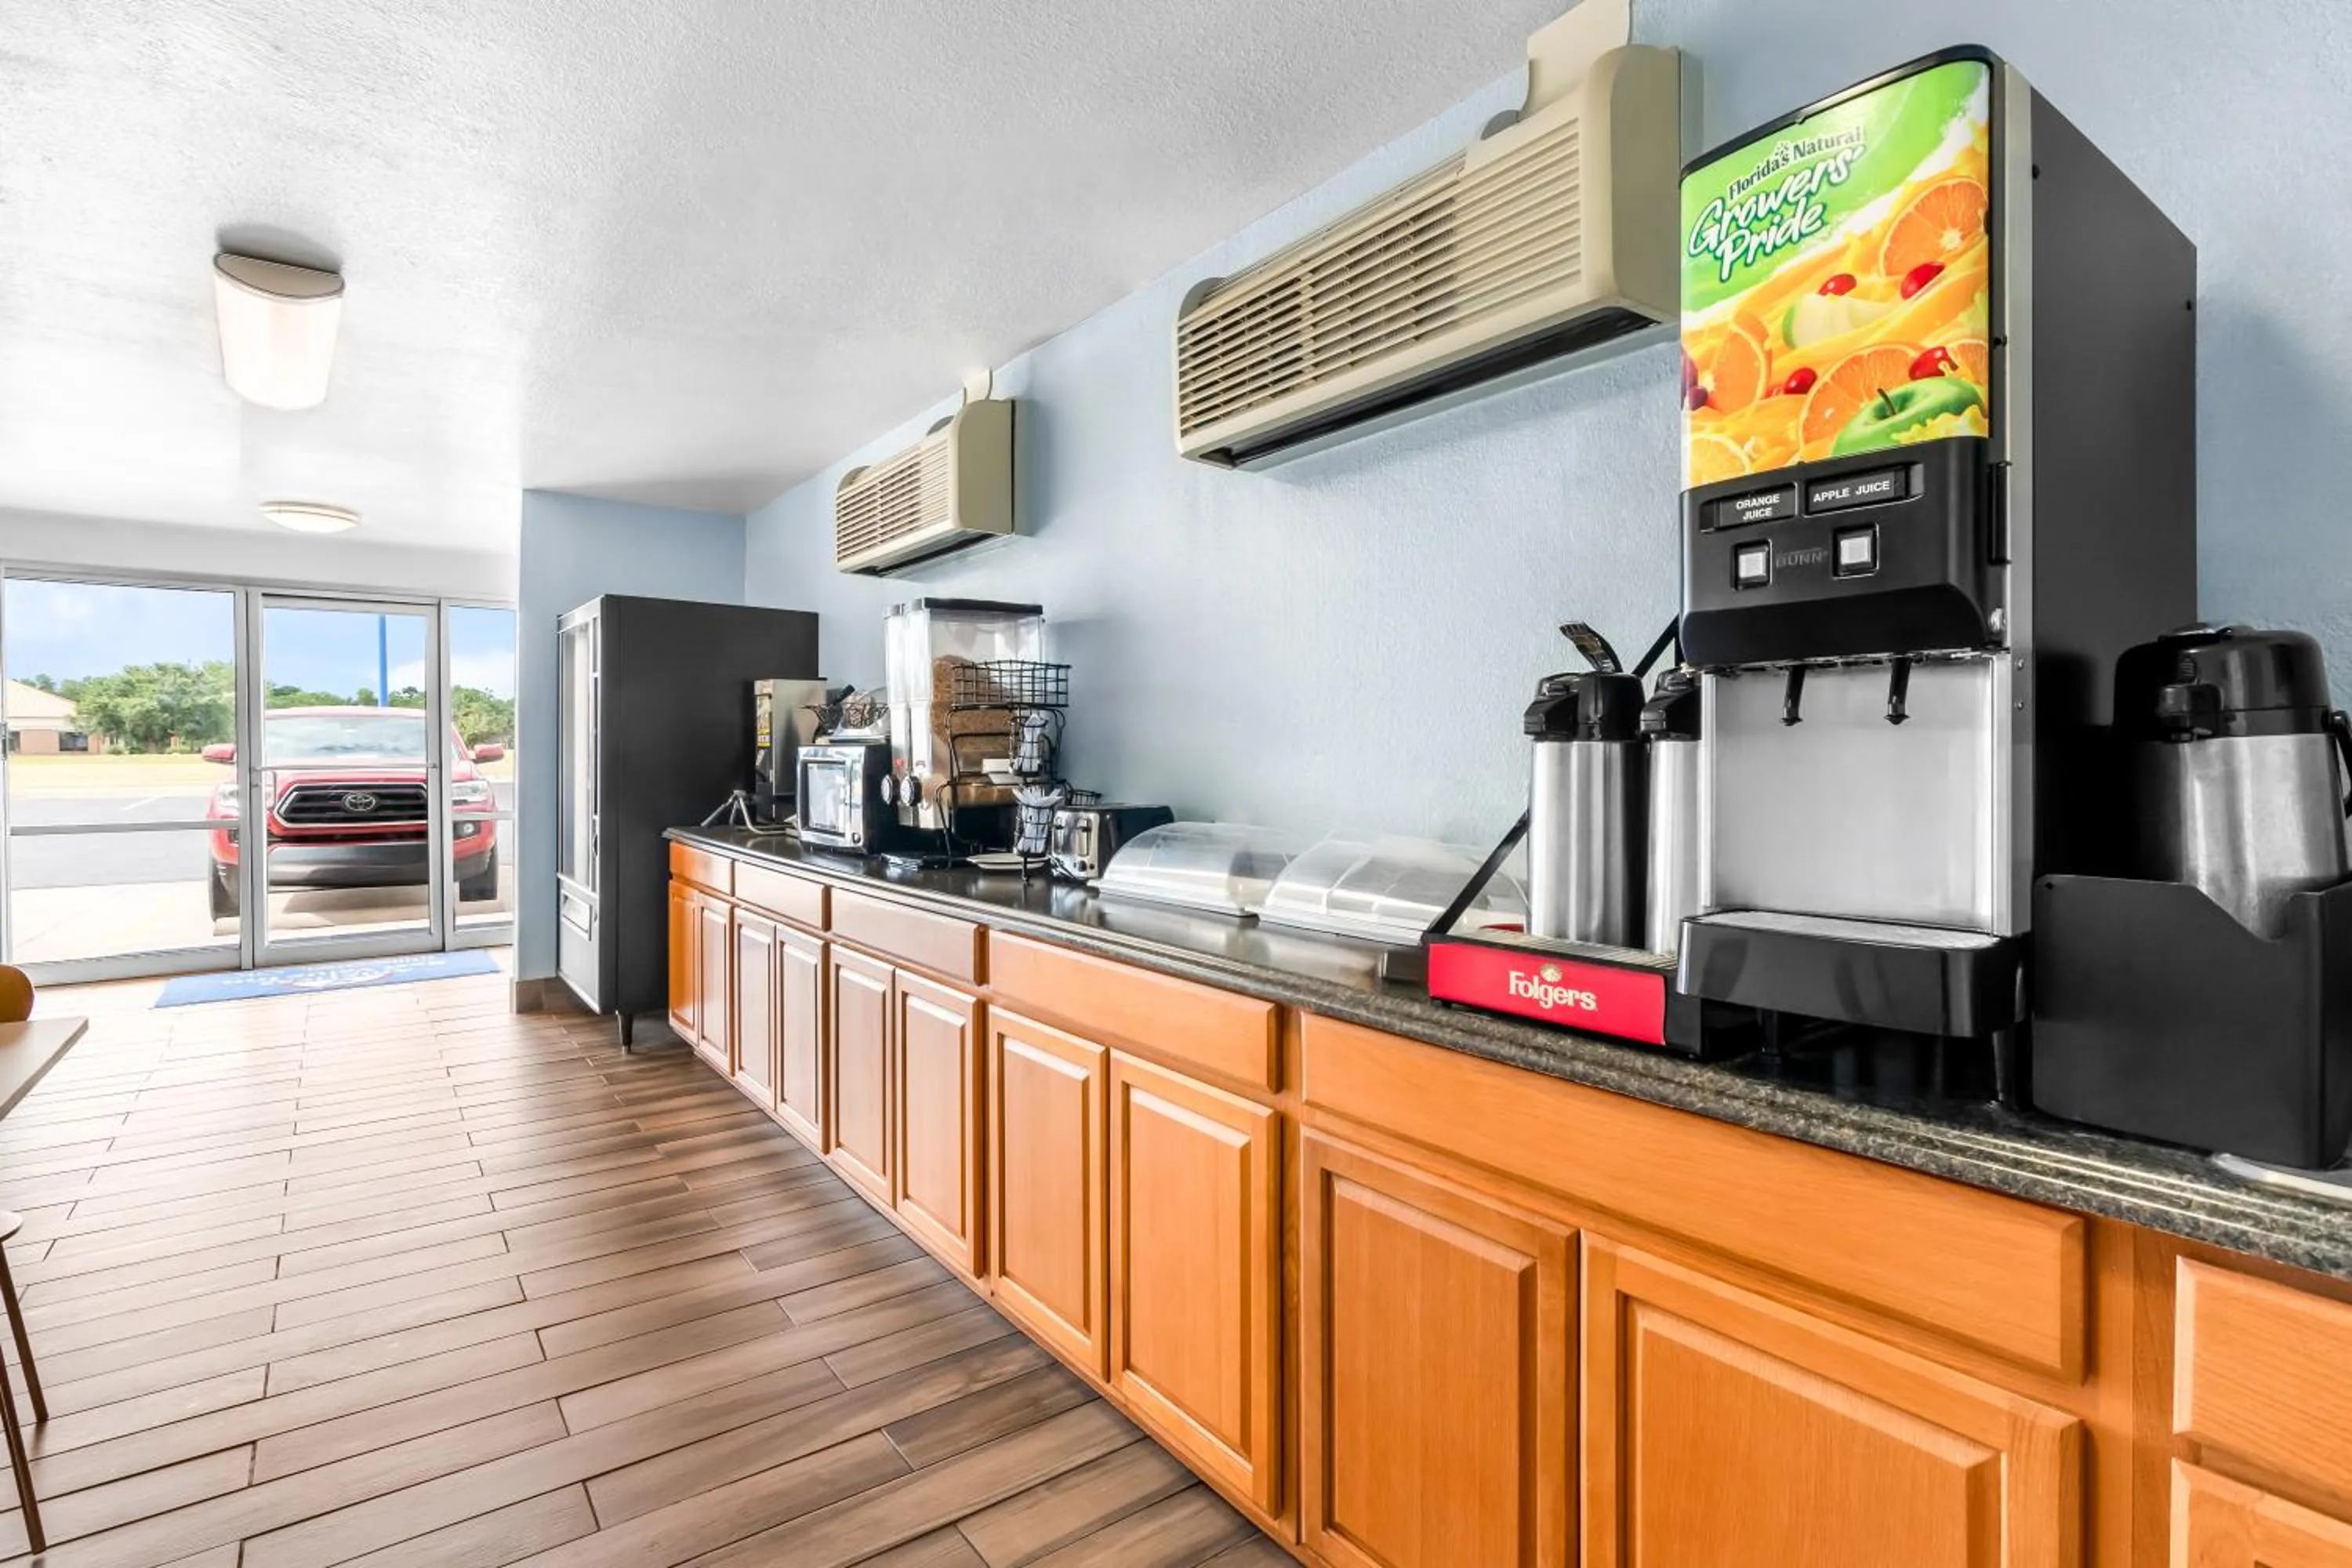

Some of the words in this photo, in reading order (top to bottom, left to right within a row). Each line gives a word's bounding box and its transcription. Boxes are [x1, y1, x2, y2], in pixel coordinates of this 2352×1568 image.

[1793, 126, 1861, 161] Natural
[1715, 197, 1828, 283] Pride
[1736, 494, 1780, 510] ORANGE
[1813, 487, 1851, 503] APPLE
[1856, 480, 1891, 495] JUICE
[1743, 507, 1773, 521] JUICE
[1508, 971, 1597, 1011] Folgers
